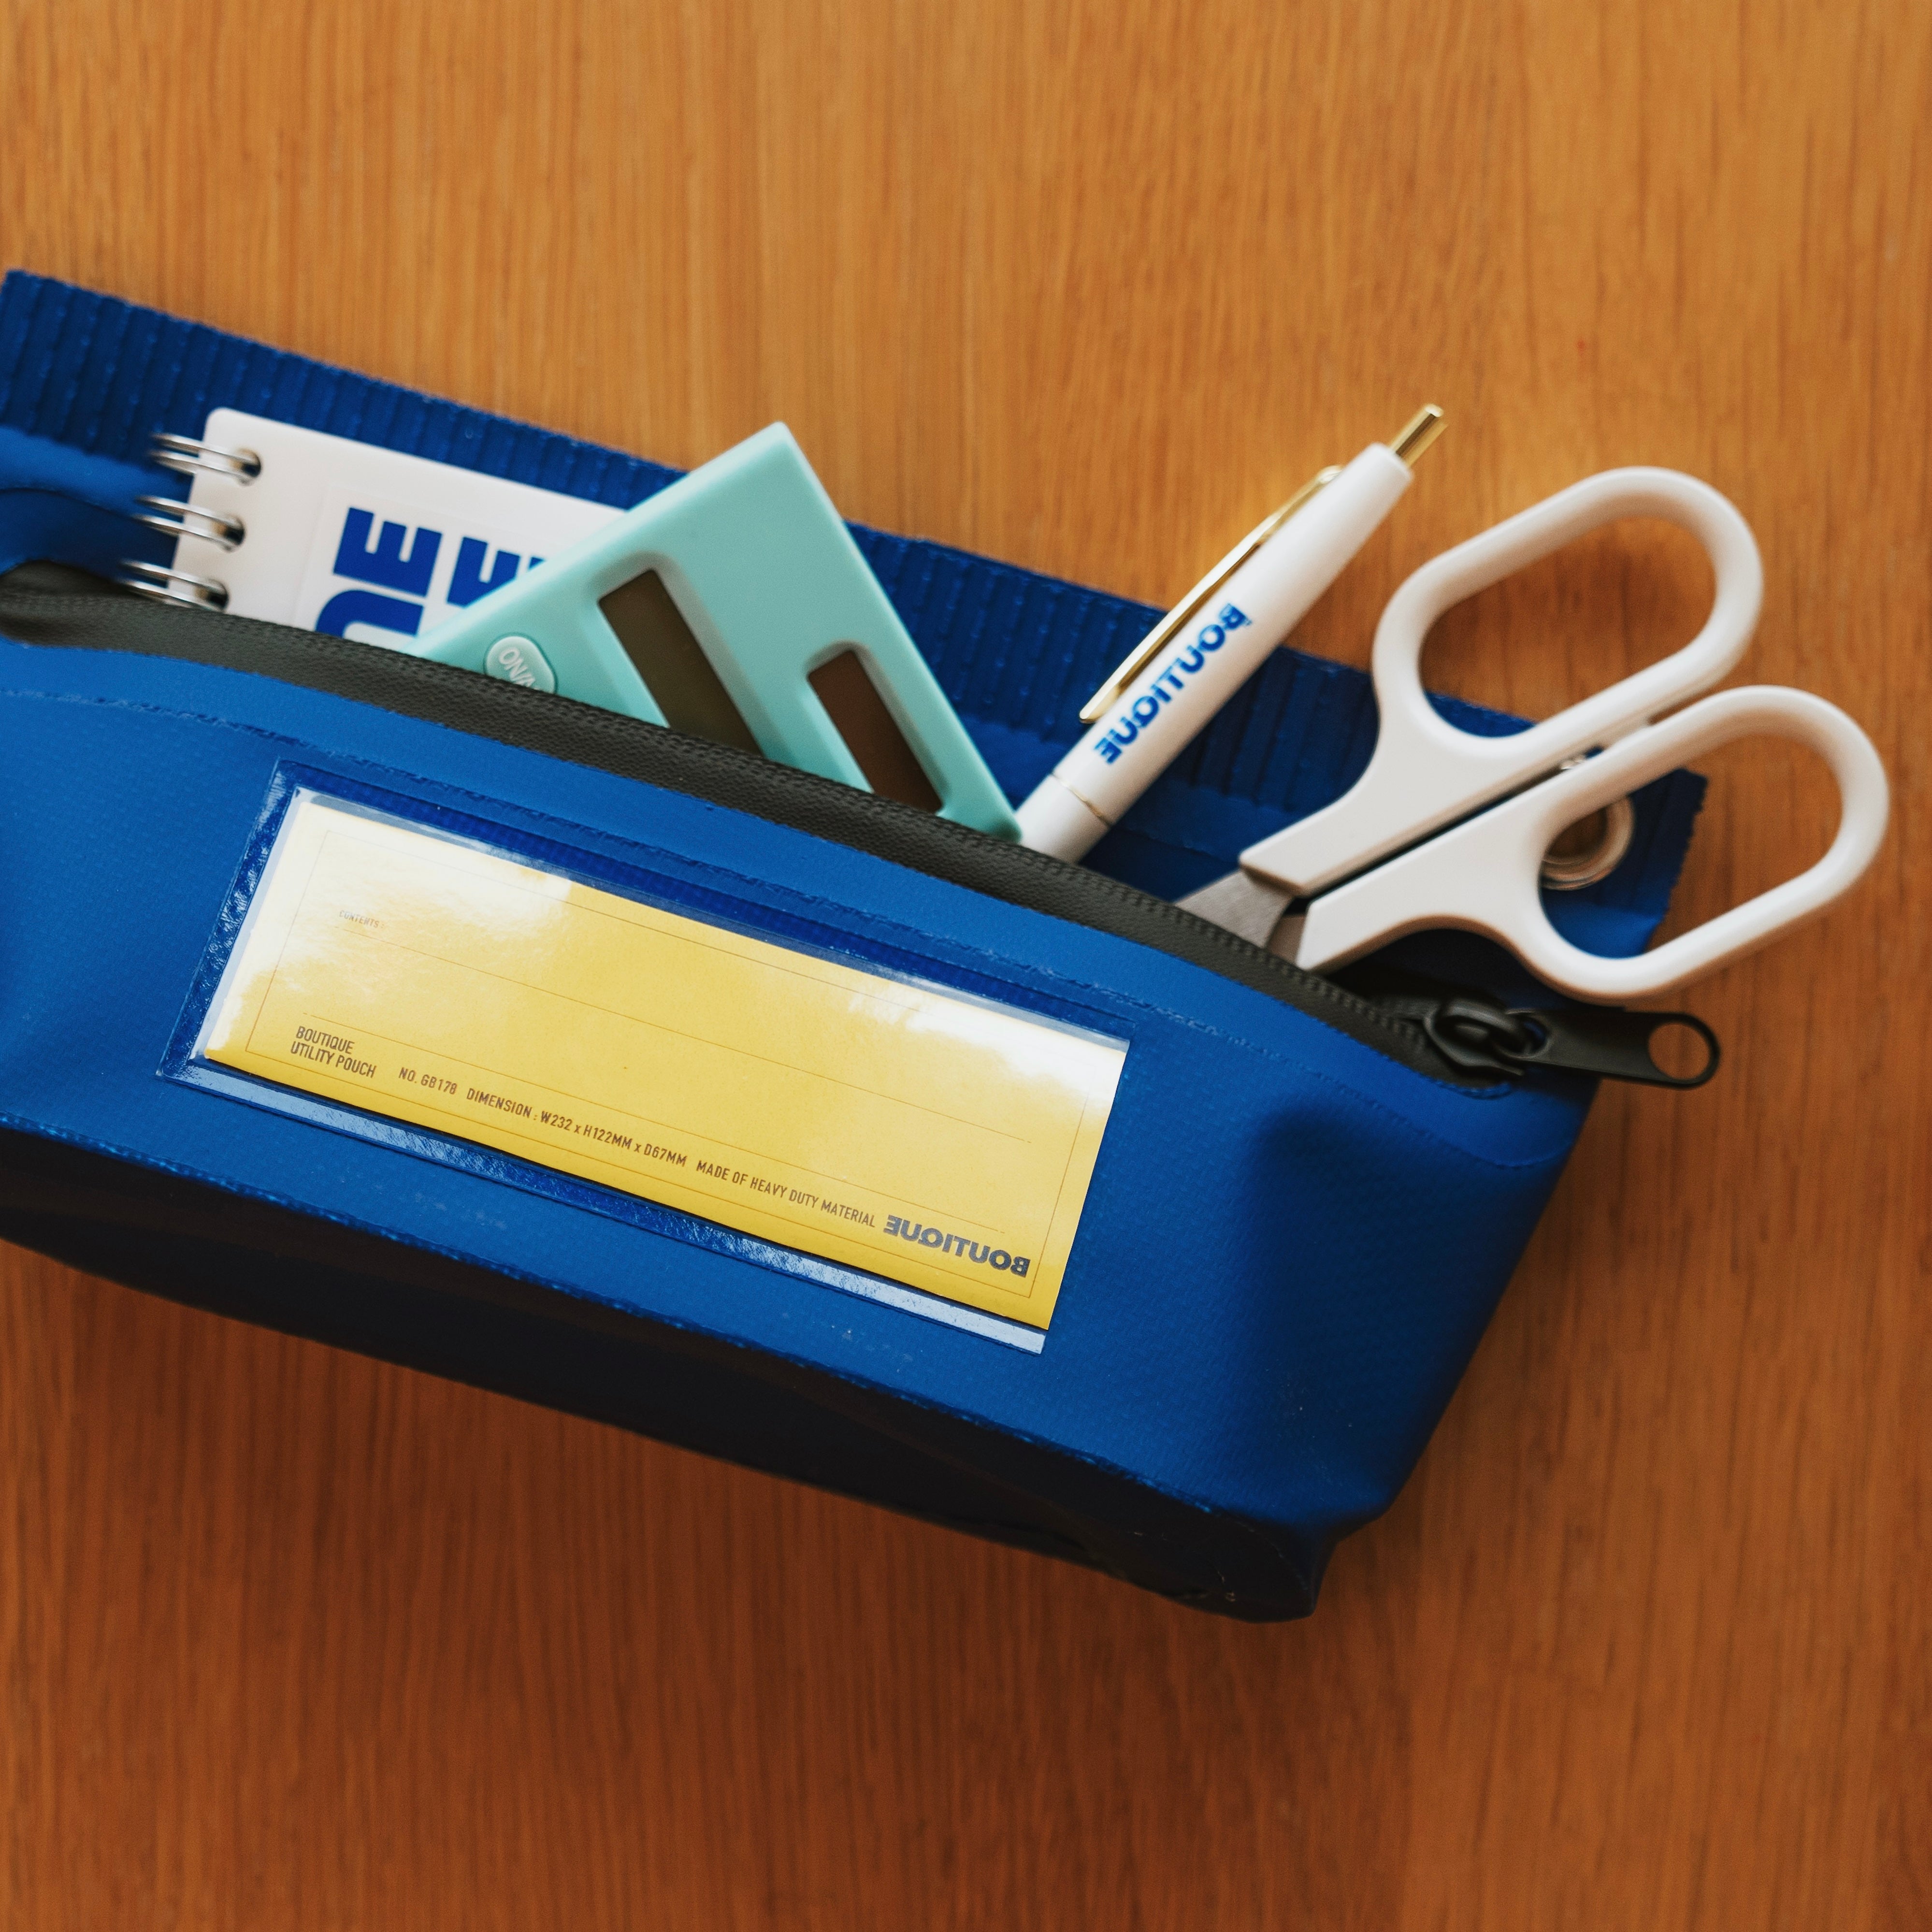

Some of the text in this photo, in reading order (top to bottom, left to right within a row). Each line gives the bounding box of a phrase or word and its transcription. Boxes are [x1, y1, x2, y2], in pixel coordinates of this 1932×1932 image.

[498, 647, 537, 690] ON/A
[339, 910, 379, 928] CONTENTS
[296, 1025, 355, 1054] BOUTIQUE
[290, 1041, 377, 1078] UTILITY POUCH
[399, 1067, 417, 1083] NO.
[421, 1074, 458, 1095] GB178
[466, 1088, 533, 1119] DIMENSION
[540, 1110, 573, 1131] W232
[583, 1125, 633, 1150] H122MM
[644, 1143, 687, 1167] D67MM
[696, 1160, 730, 1181] MADE
[732, 1171, 748, 1185] OF
[750, 1177, 787, 1198] HEAVY
[789, 1190, 819, 1208] DUTY
[821, 1199, 876, 1228] MATERIAL
